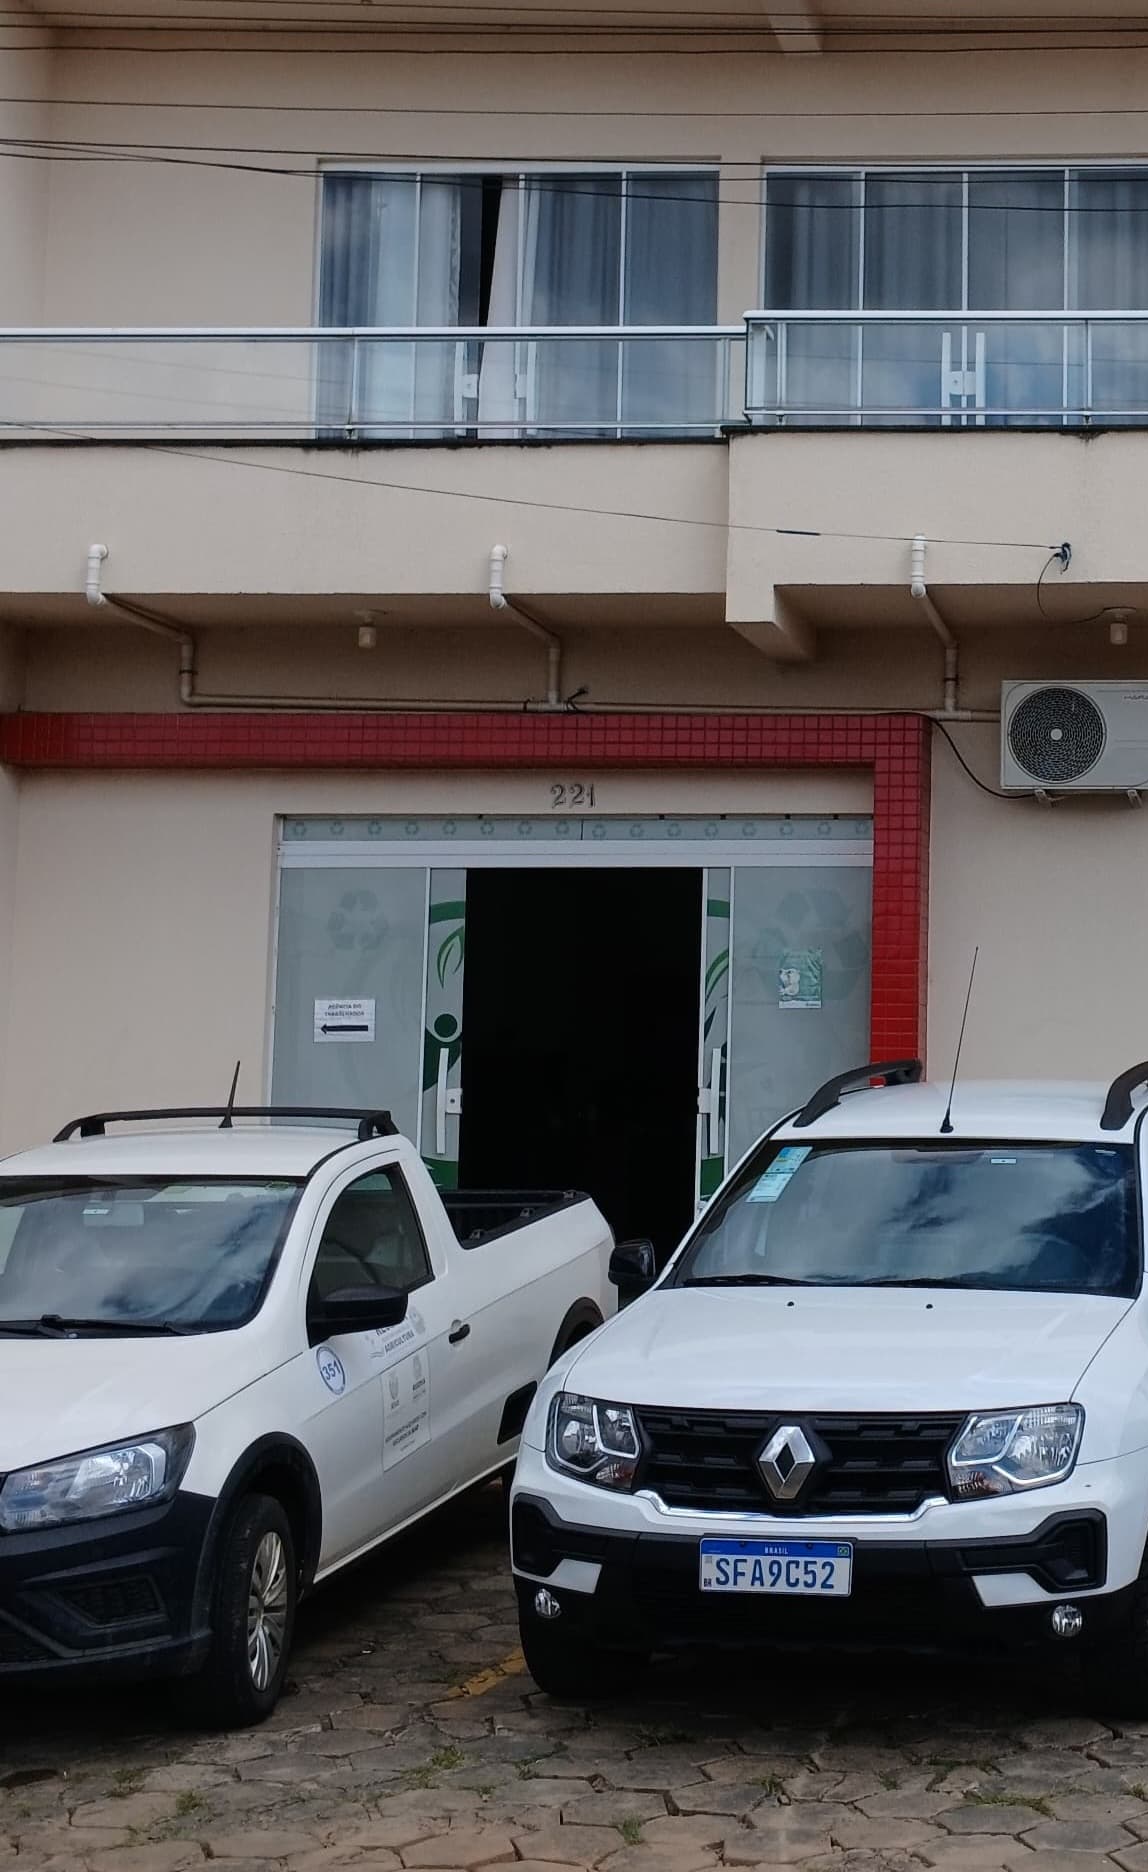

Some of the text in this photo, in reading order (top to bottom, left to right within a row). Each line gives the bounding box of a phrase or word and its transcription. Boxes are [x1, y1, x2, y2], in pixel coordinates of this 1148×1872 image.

[550, 783, 595, 809] 221
[322, 1360, 340, 1380] 351
[764, 1547, 789, 1555] BRASIL
[715, 1557, 835, 1589] SFA9C52
